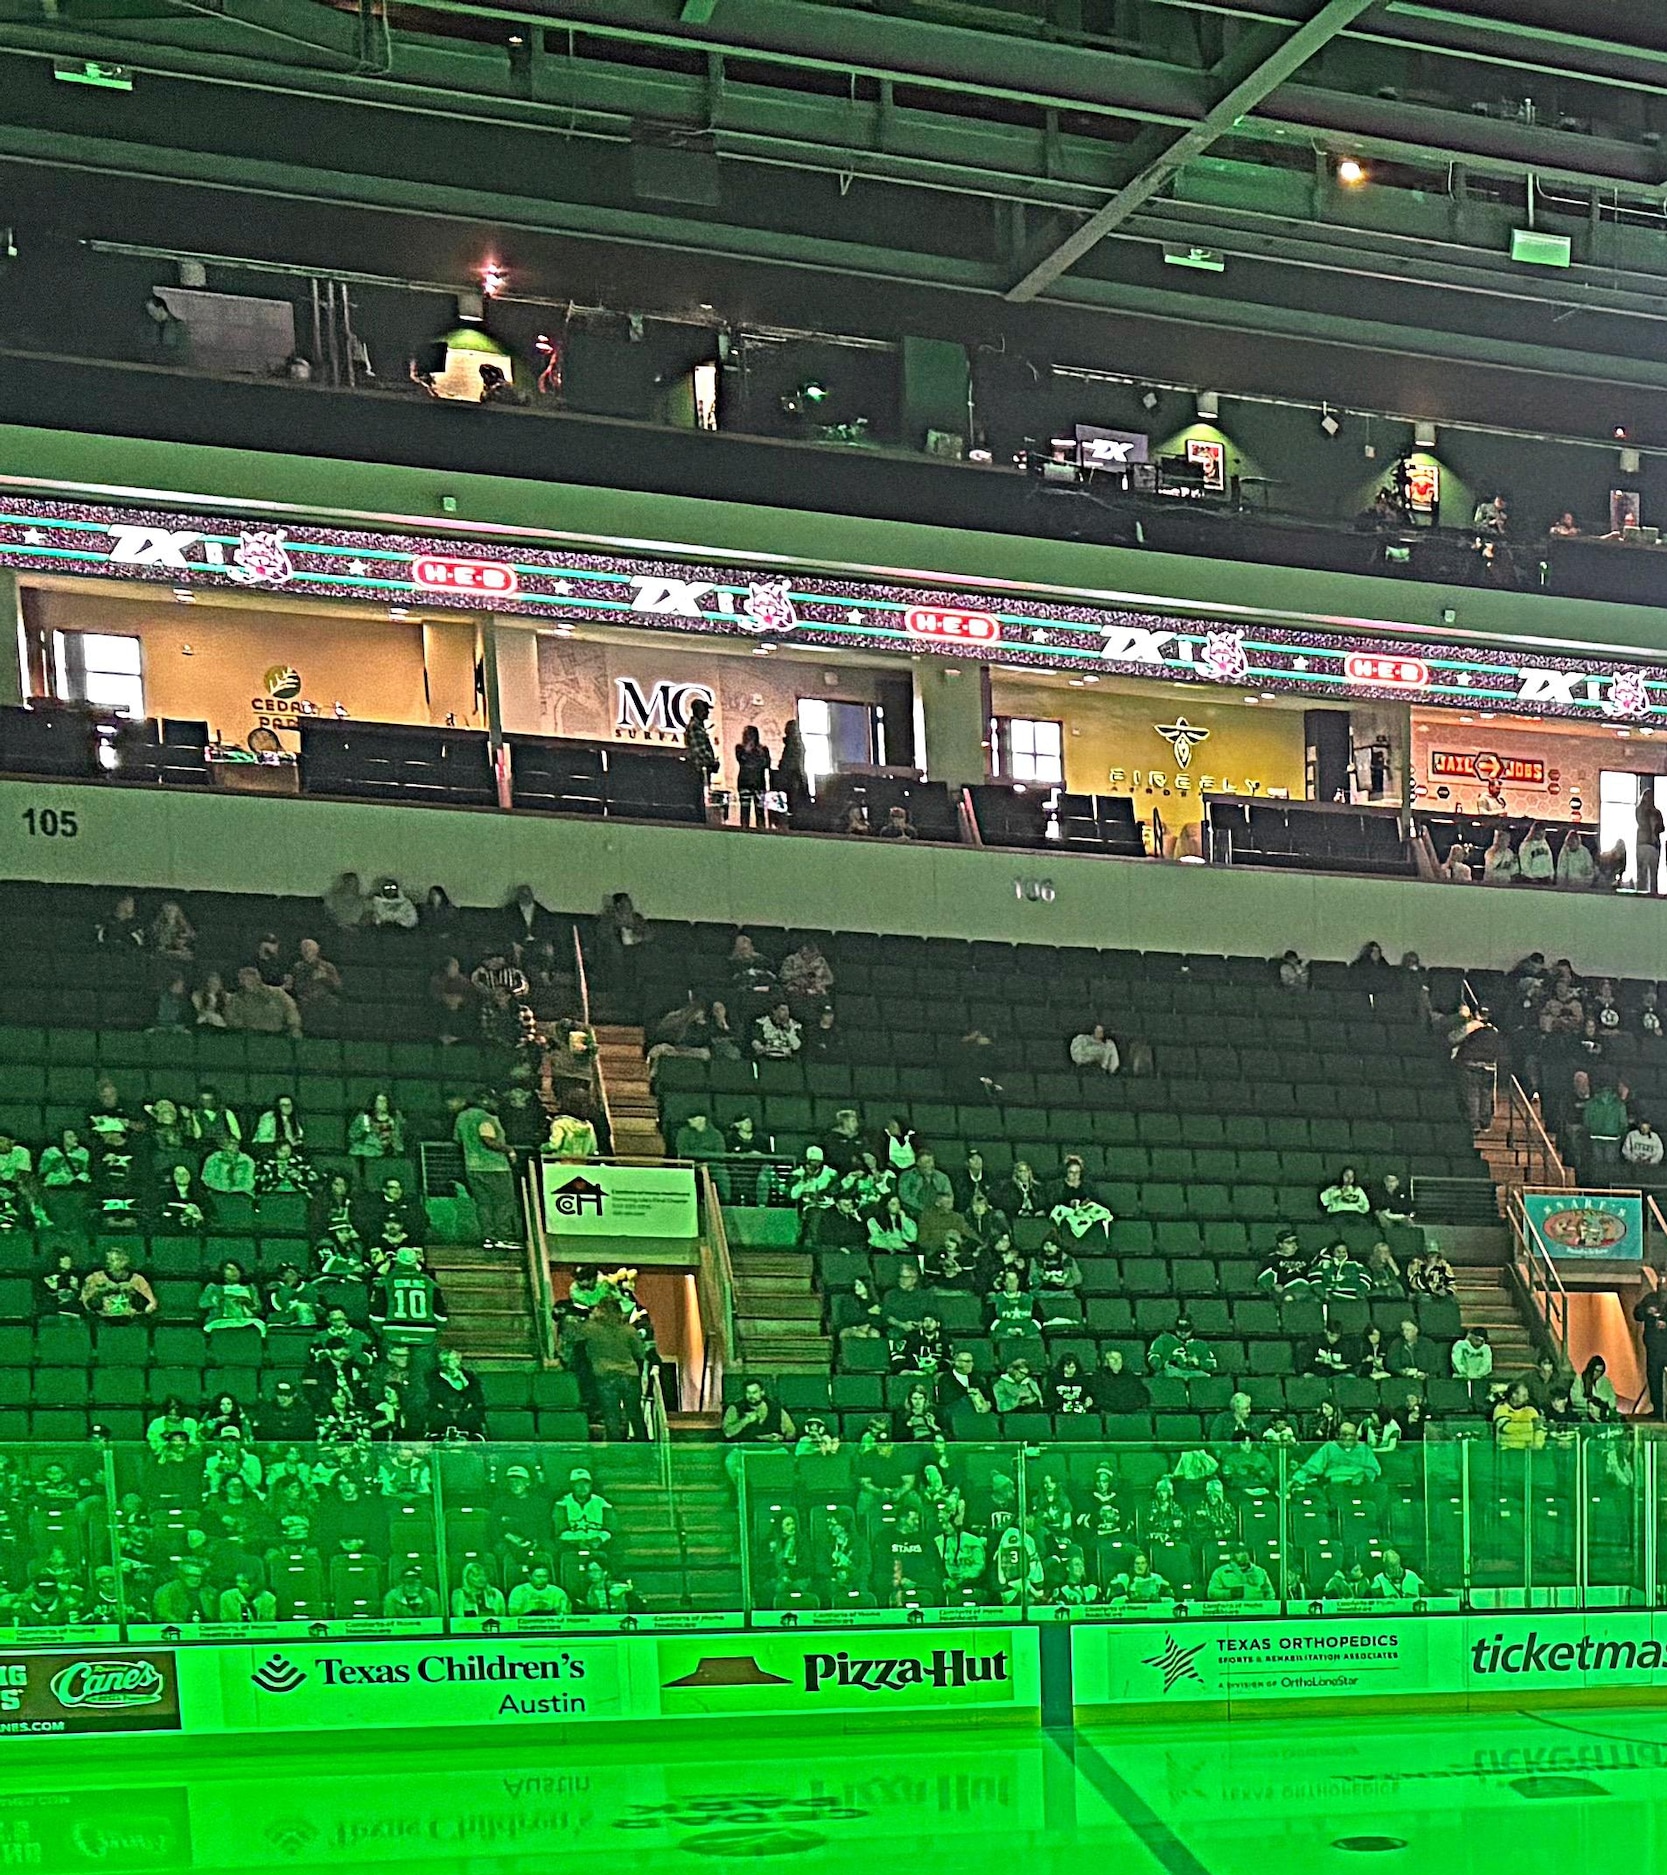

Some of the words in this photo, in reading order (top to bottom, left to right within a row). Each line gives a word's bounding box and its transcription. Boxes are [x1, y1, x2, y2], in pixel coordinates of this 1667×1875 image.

[1435, 752, 1475, 775] JAIL
[1501, 757, 1544, 783] JOBS
[22, 808, 78, 838] 105
[1217, 1638, 1271, 1651] TEXAS
[1279, 1635, 1398, 1649] ORTHOPEDICS
[1344, 1652, 1398, 1660] ASSOCIATES
[315, 1656, 411, 1685] Texas
[417, 1652, 586, 1683] Children's
[804, 1650, 923, 1693] Pizza
[923, 1648, 1009, 1688] Hut
[498, 1693, 587, 1716] Austin
